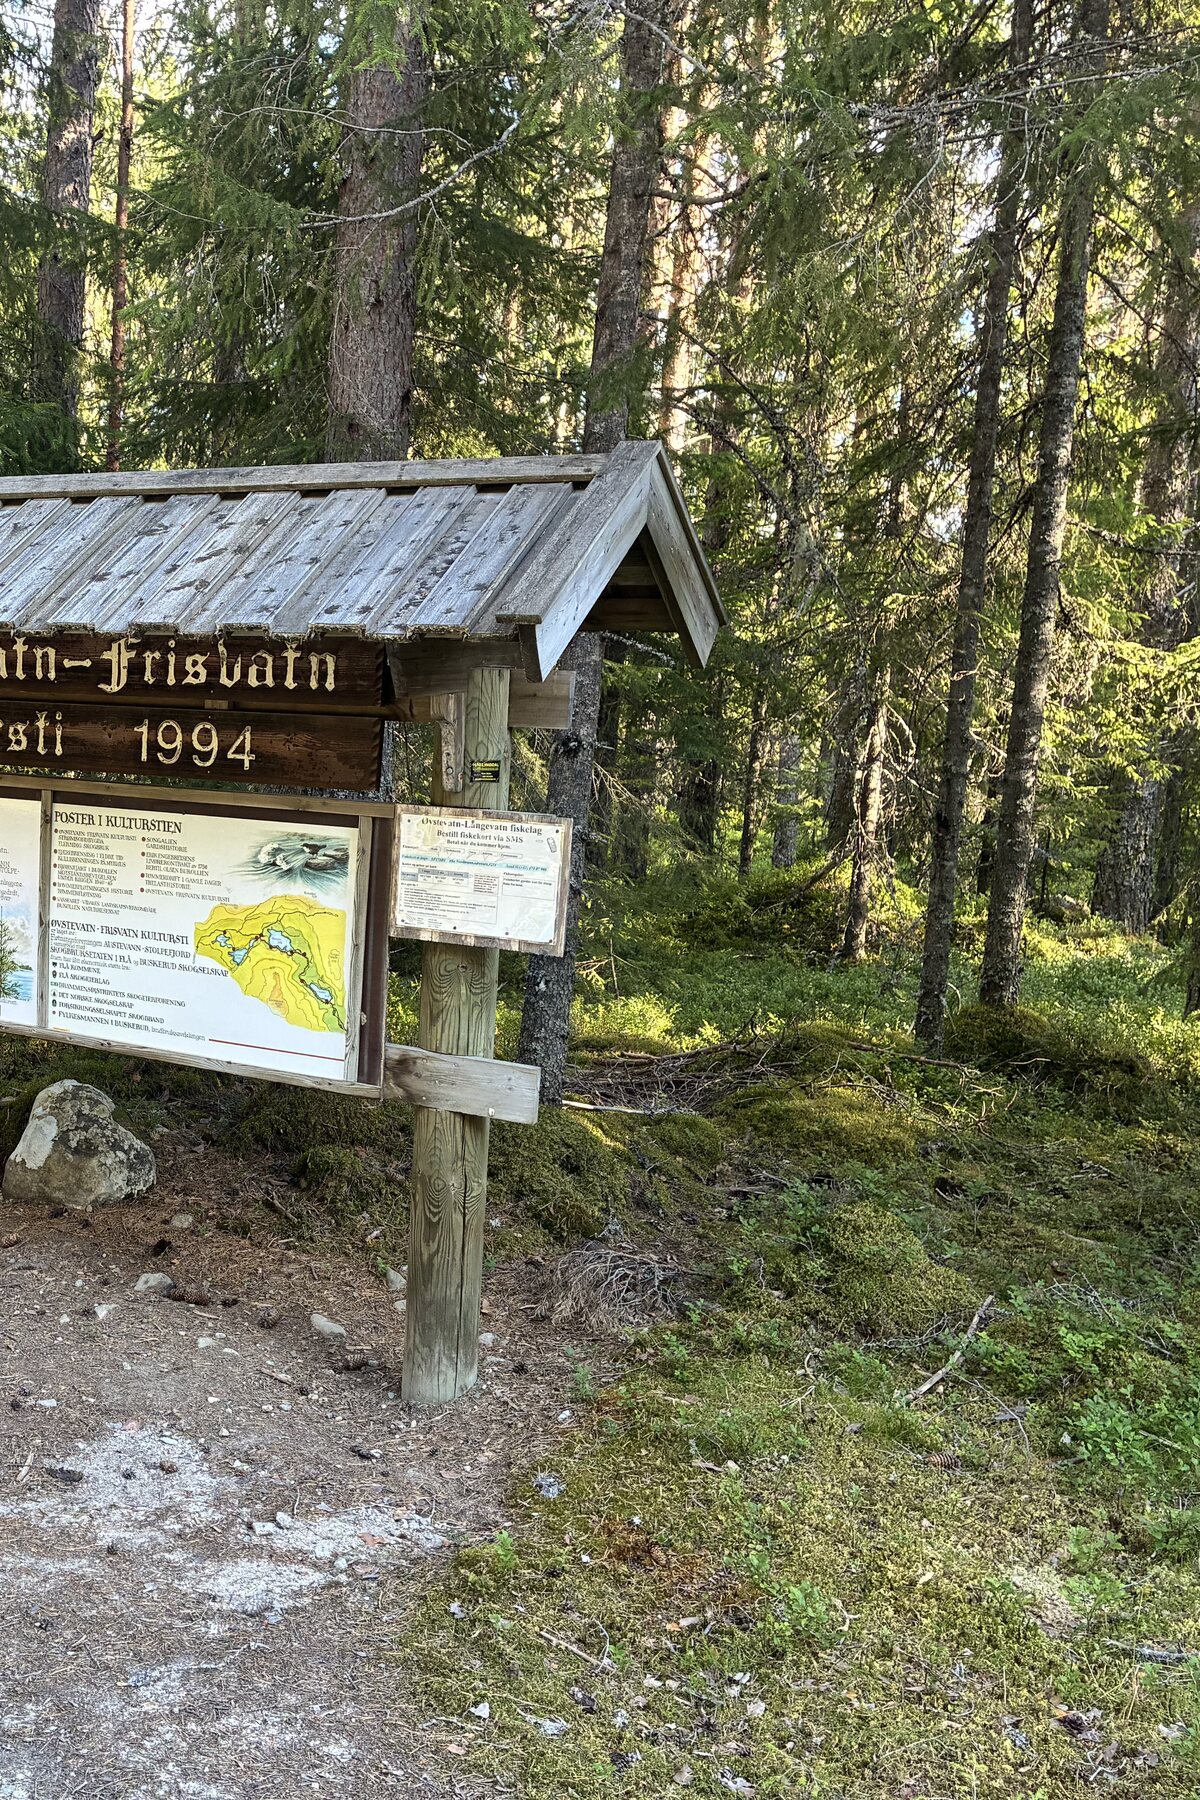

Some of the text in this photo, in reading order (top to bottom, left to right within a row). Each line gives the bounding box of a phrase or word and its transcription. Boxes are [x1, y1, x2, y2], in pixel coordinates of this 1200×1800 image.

[133, 718, 256, 771] 1994
[53, 810, 182, 834] POSTER I KULTURSTIEN
[510, 824, 542, 835] fiskelag
[436, 829, 458, 837] Bestill
[460, 831, 491, 840] fiskekort
[505, 835, 523, 843] SMS
[140, 930, 188, 945] KULTURSTI
[139, 958, 176, 970] BUSKERUD
[177, 963, 228, 978] SKOGSELSKAP
